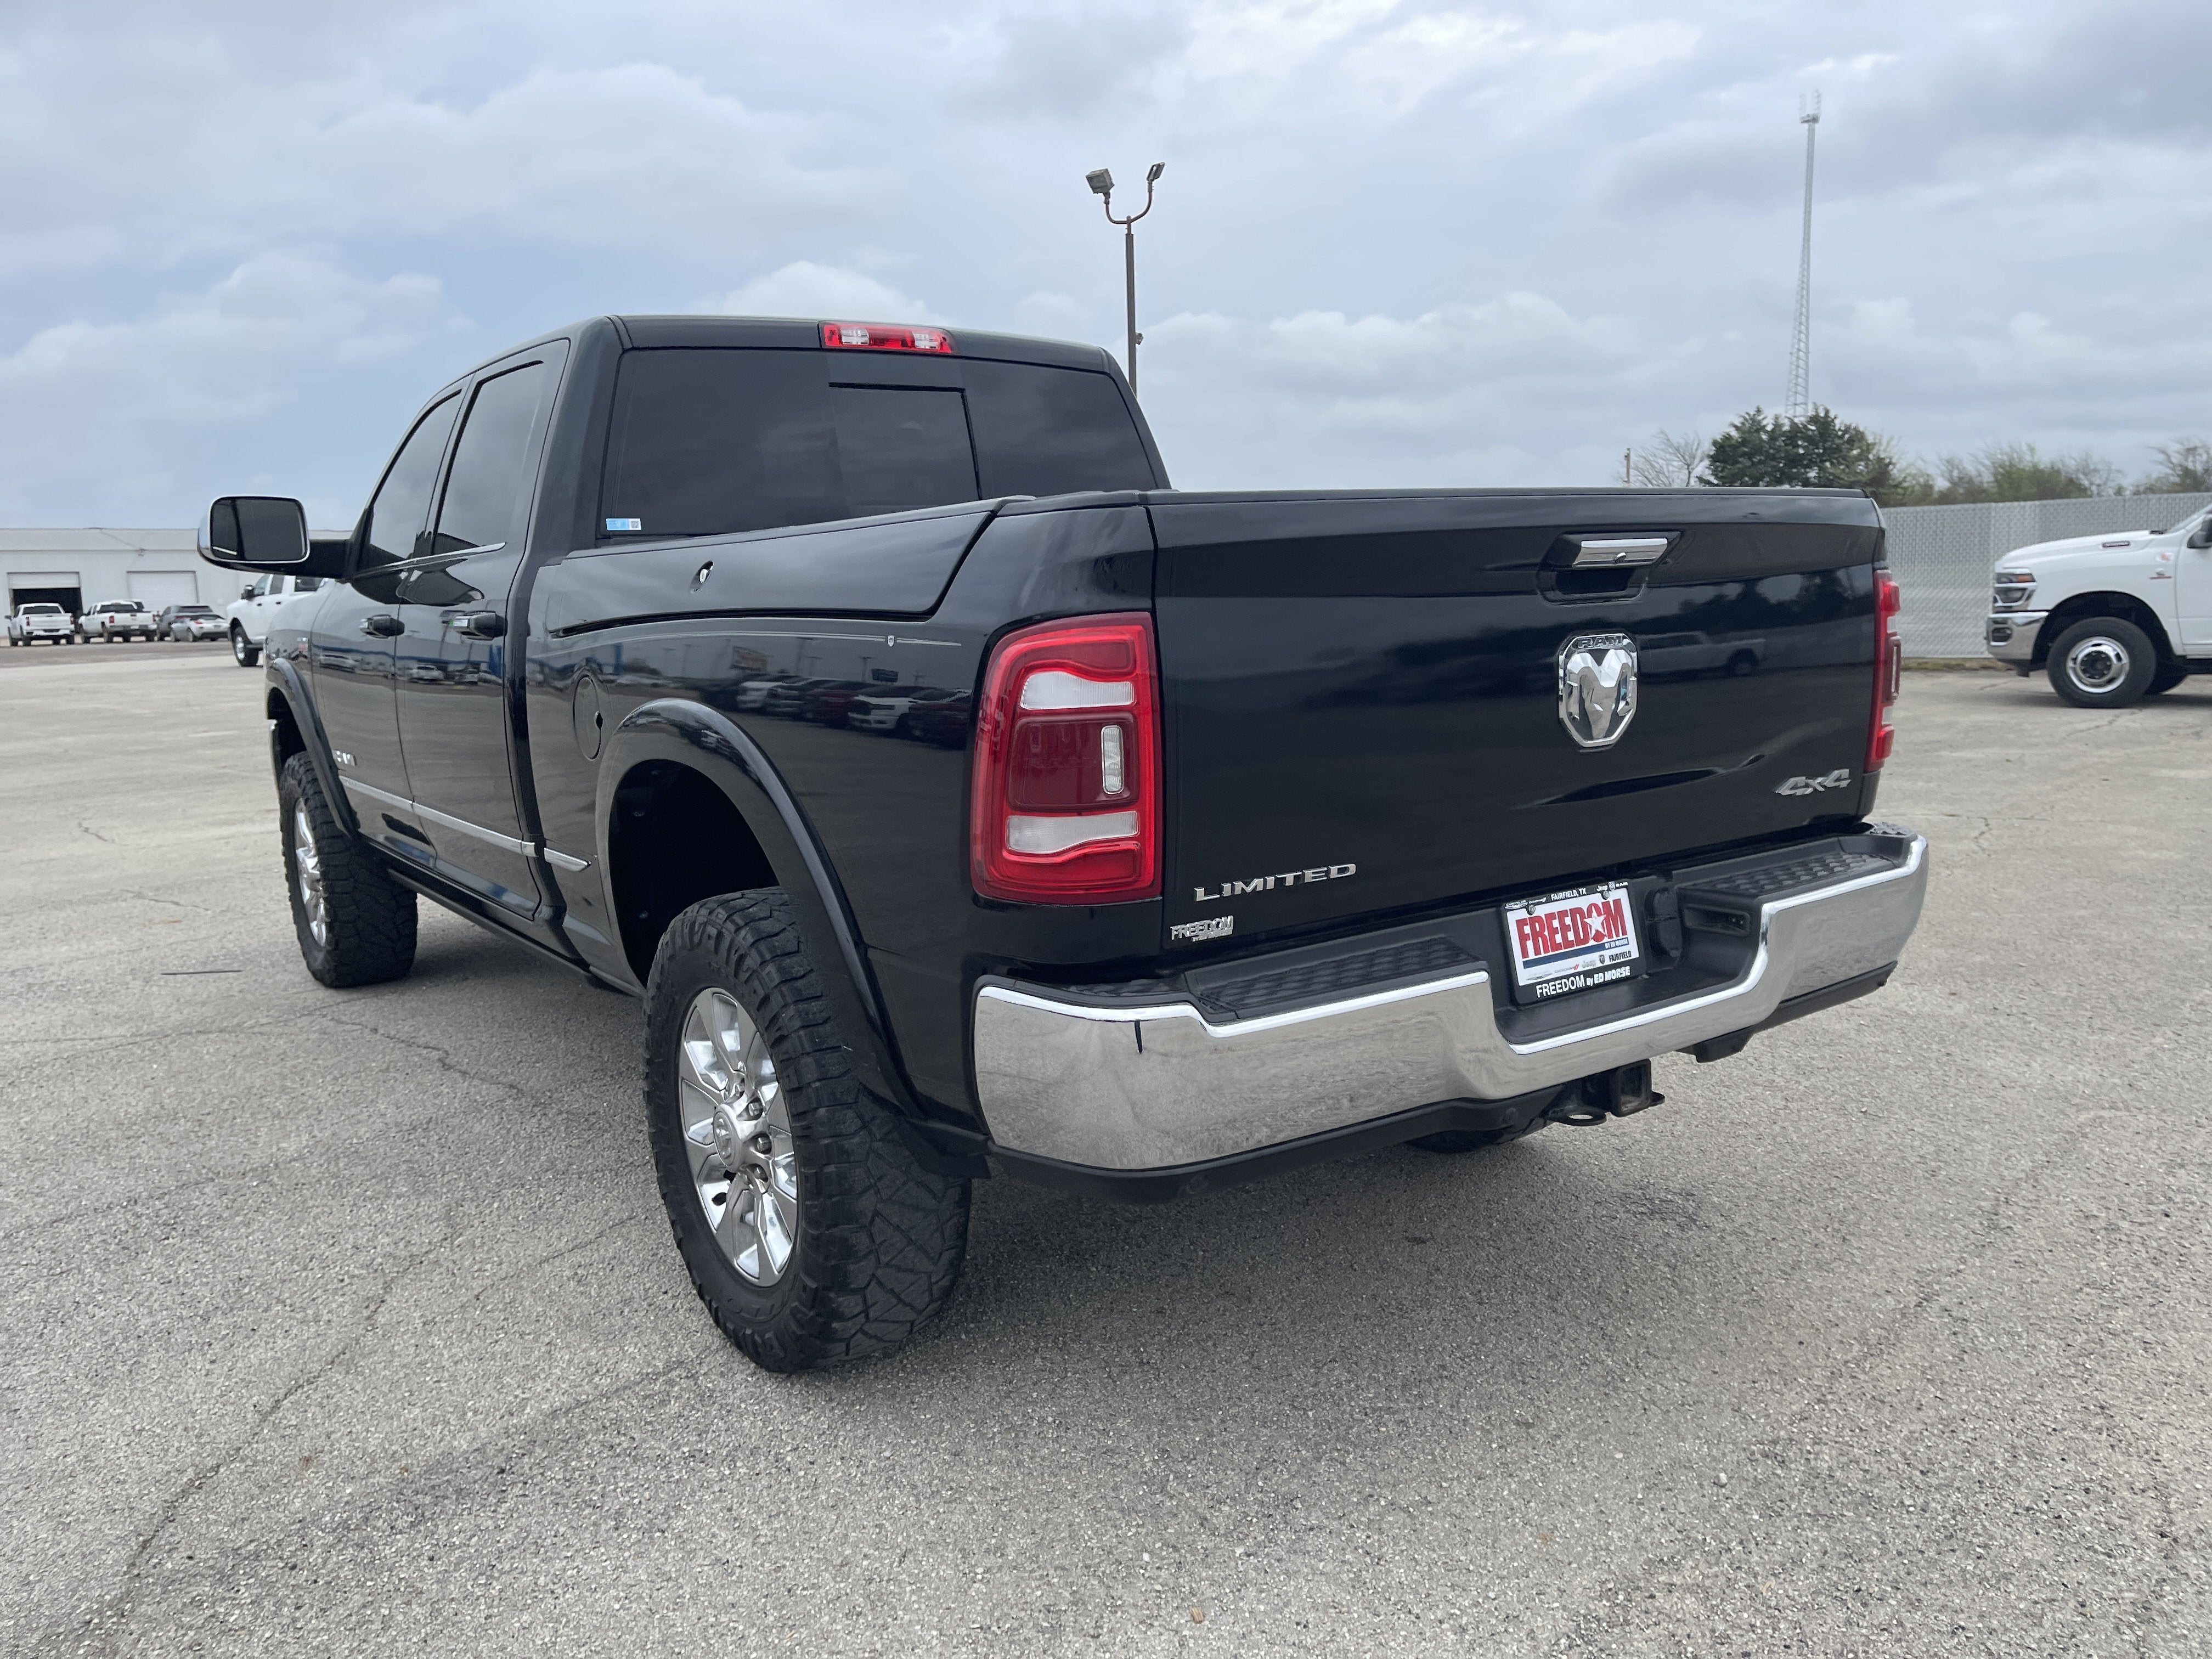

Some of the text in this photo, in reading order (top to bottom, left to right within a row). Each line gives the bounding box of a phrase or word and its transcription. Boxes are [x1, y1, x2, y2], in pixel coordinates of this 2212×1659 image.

[1578, 636, 1623, 648] RAM
[1194, 863, 1357, 901] LIMITED
[1170, 915, 1234, 940] FREEDOM
[1515, 898, 1628, 959] FREEDOM
[1609, 950, 1632, 962] FAIRFIELD
[1536, 974, 1585, 998] FREEDOM
[1594, 973, 1604, 984] ED
[1604, 966, 1630, 981] MORSE
